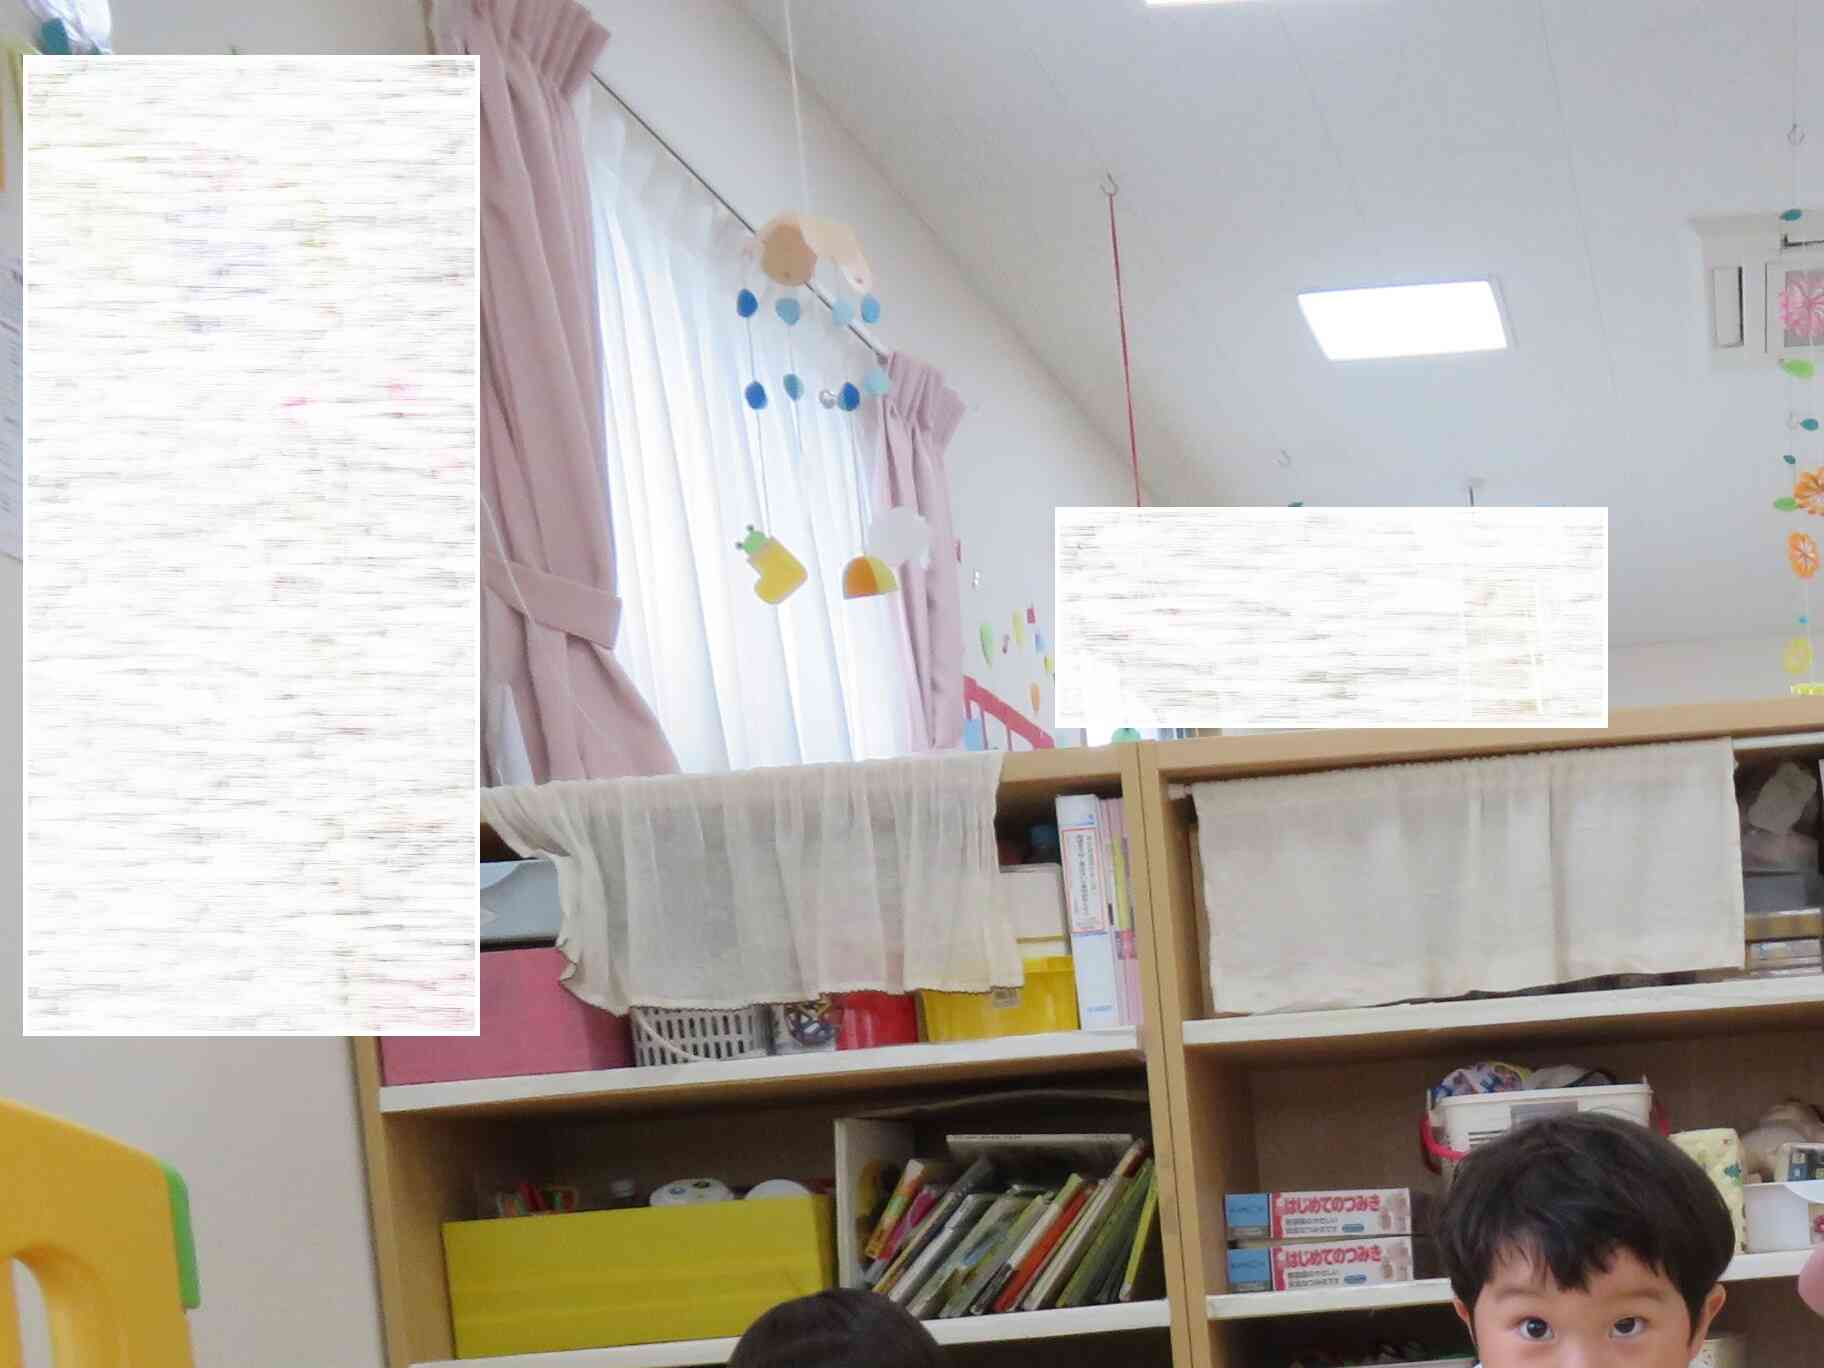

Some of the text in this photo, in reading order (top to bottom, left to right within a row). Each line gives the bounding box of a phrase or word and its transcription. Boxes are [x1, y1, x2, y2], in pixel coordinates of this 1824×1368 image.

[1284, 1194, 1380, 1214] はじめてのつみき
[1286, 1244, 1382, 1268] はじめてのつみき
